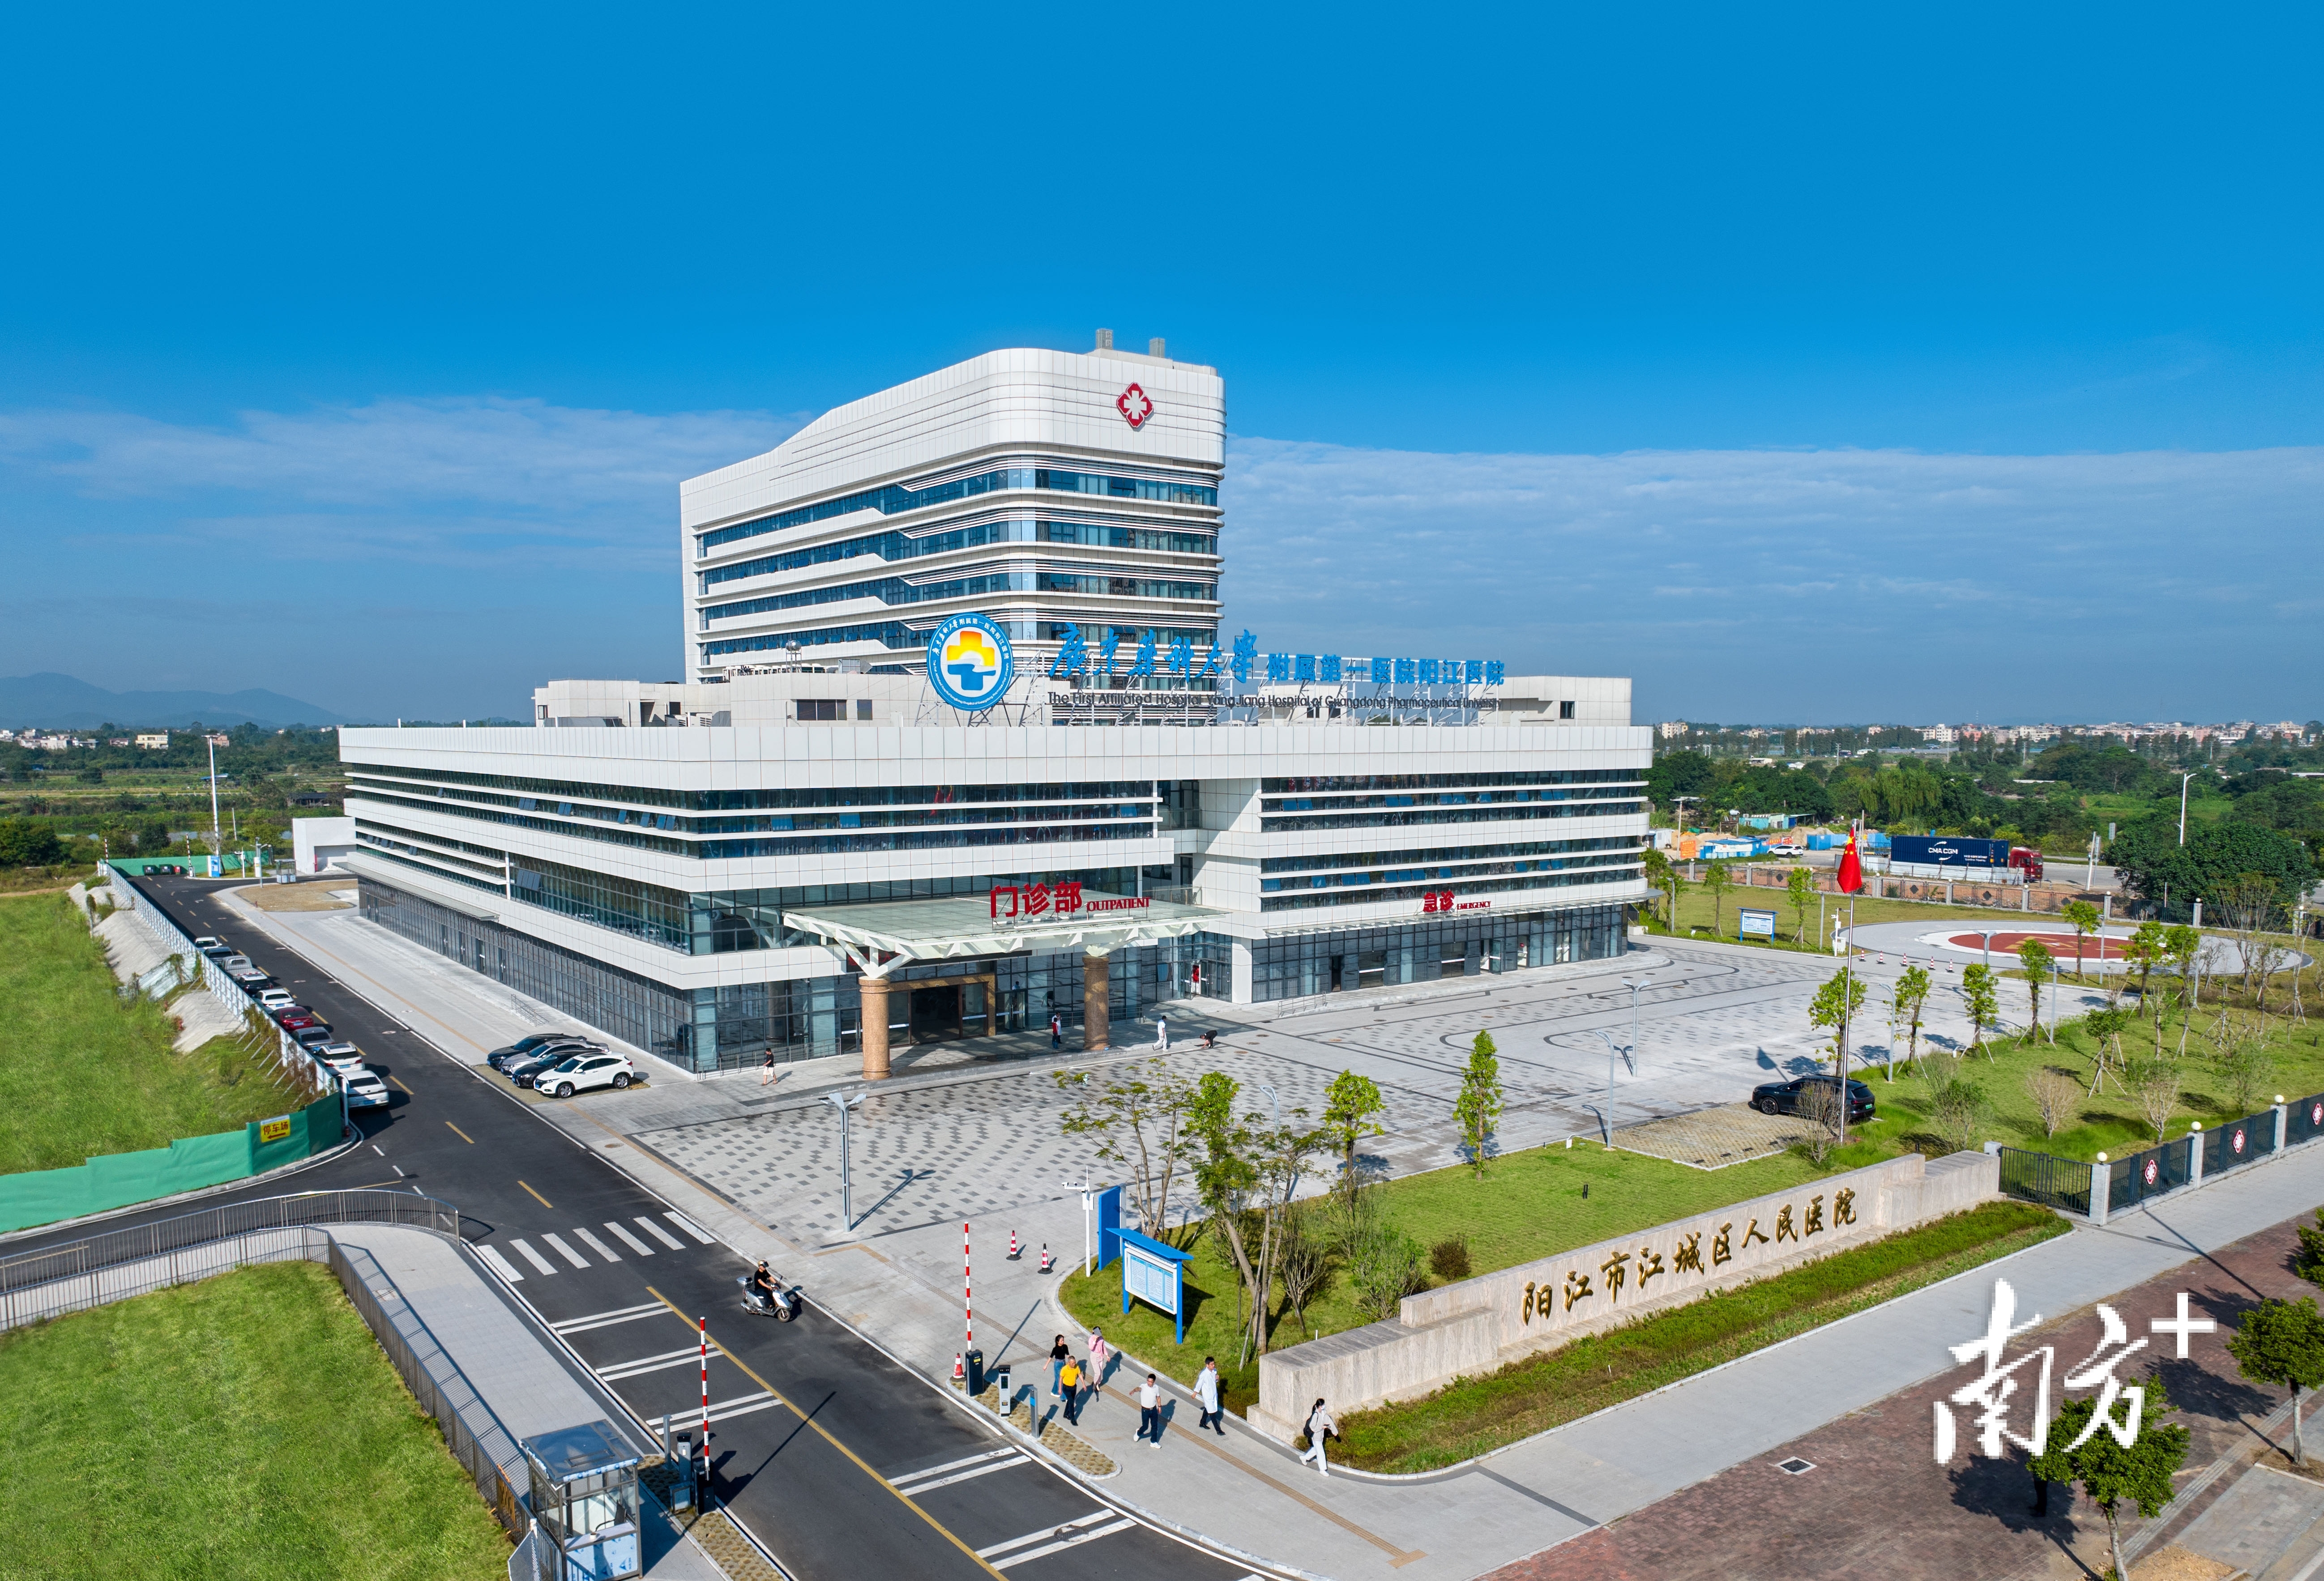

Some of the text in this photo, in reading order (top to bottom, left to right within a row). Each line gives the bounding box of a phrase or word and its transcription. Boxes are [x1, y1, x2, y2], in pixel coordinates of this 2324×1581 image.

[1047, 692, 1069, 704] The
[1072, 692, 1095, 704] First
[1098, 692, 1152, 706] Affiliated
[1156, 693, 1202, 707] Hospital
[1268, 695, 1310, 707] Hospital
[1312, 695, 1323, 707] of
[1325, 695, 1386, 709] Guangdong
[1388, 696, 1461, 708] Pharmaceutical
[991, 881, 1151, 918] 门诊部 OUTPATIENT
[1423, 890, 1492, 913] 急诊 EMERGENCY
[263, 1121, 289, 1135] 停车场
[1521, 1187, 1857, 1326] 阳江市江城区人民医院
